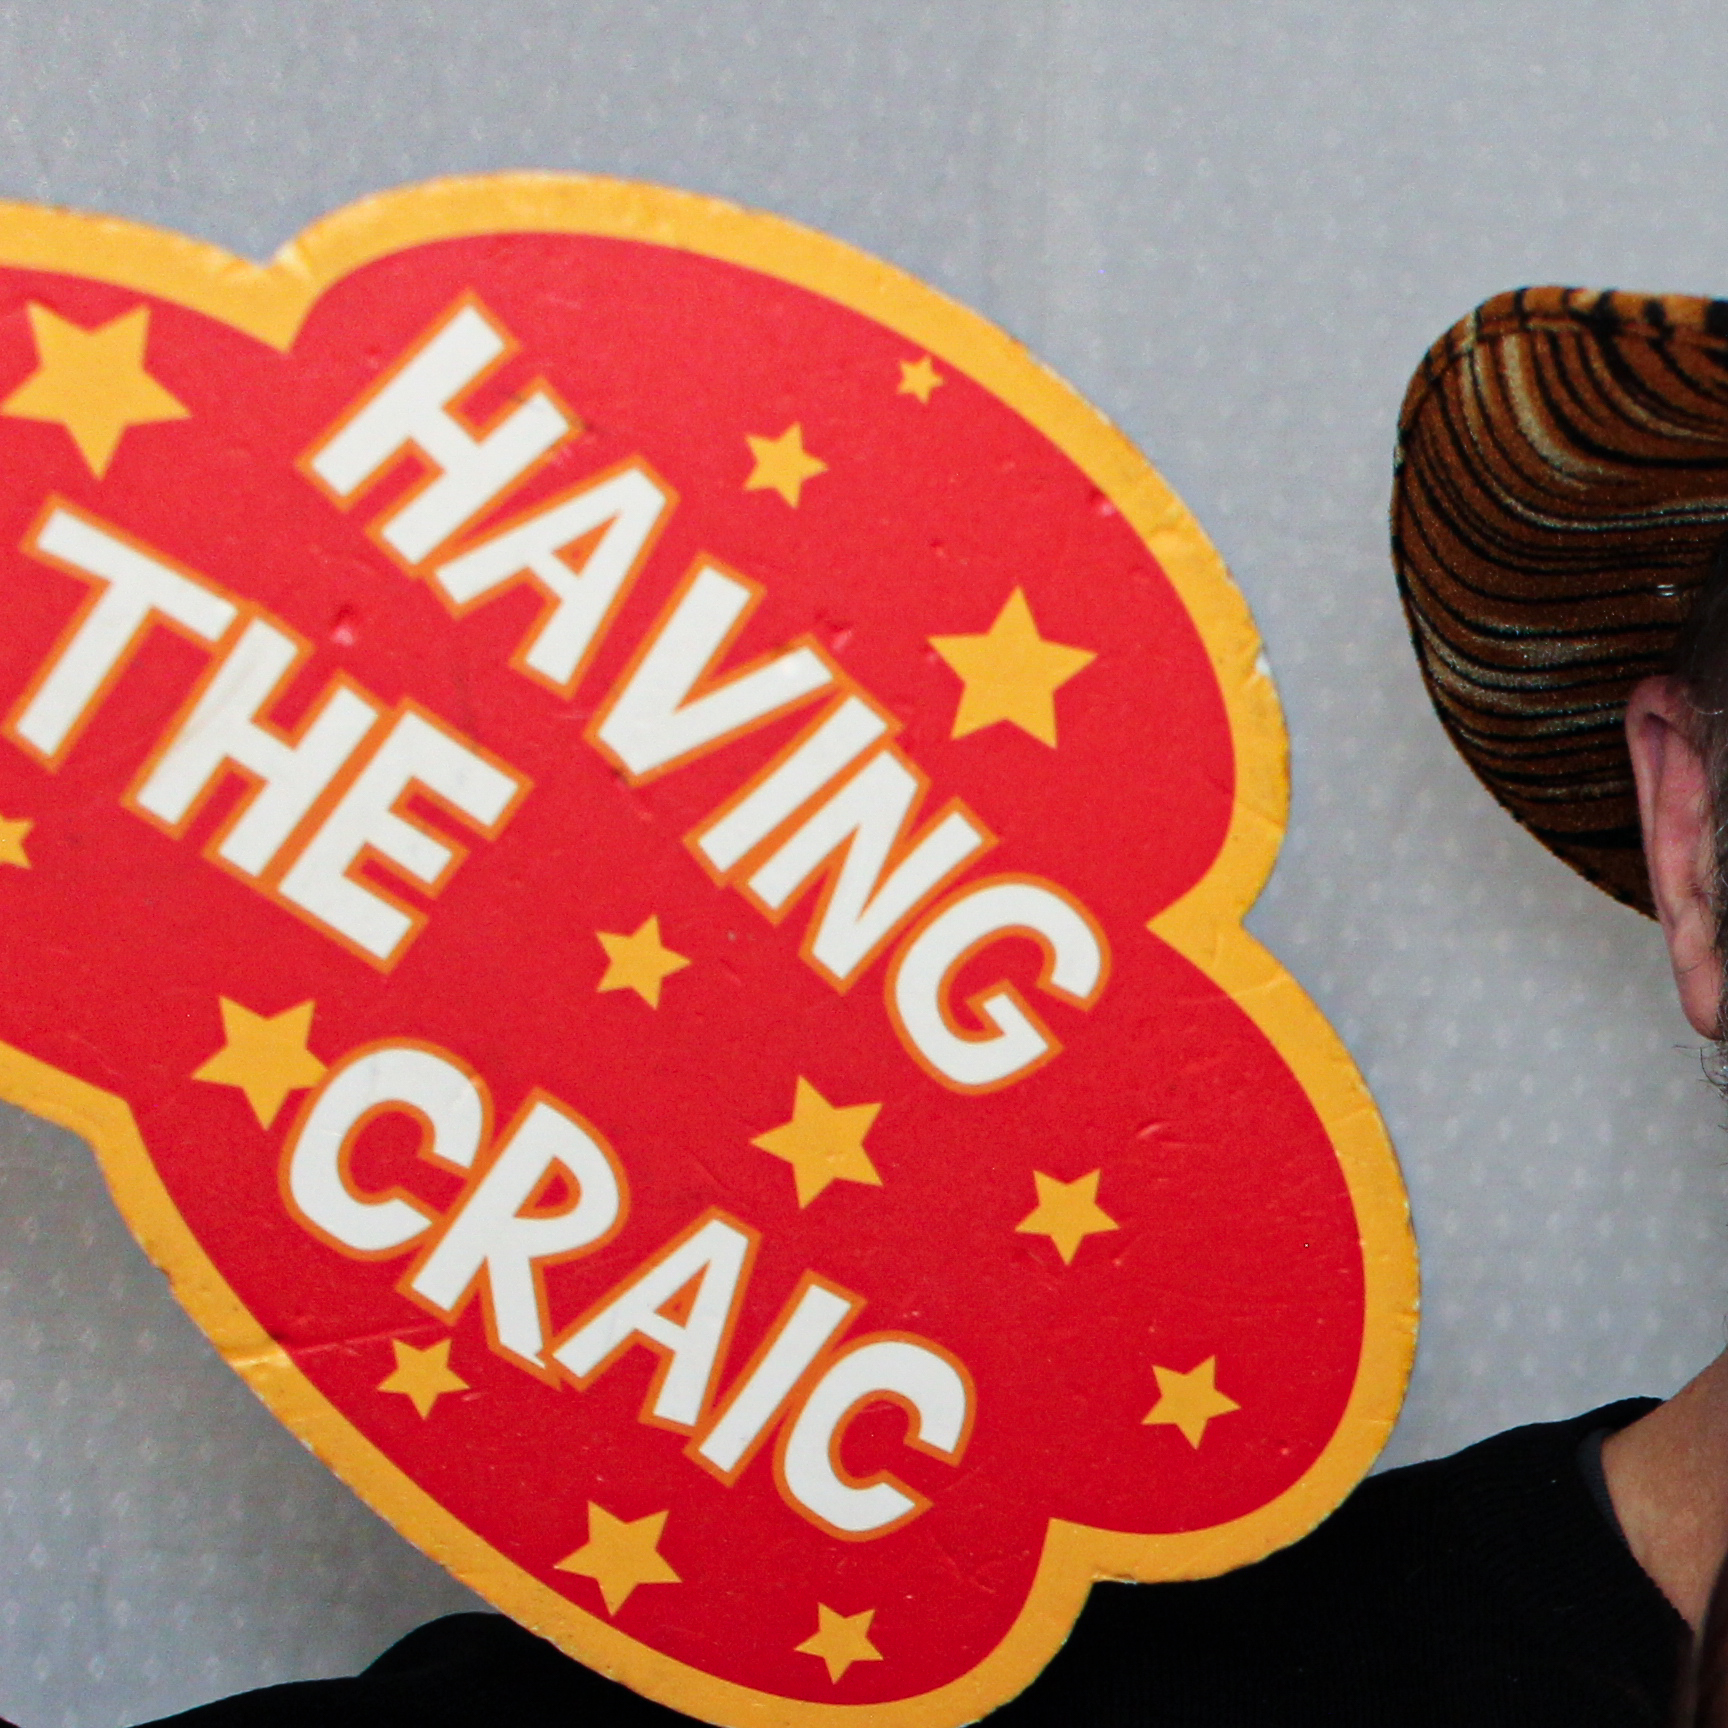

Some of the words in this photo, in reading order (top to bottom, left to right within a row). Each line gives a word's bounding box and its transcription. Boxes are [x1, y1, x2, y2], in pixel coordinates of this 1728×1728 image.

[8, 498, 528, 968] THE
[307, 298, 1106, 1092] HAVING
[282, 1042, 974, 1540] CRAIC
